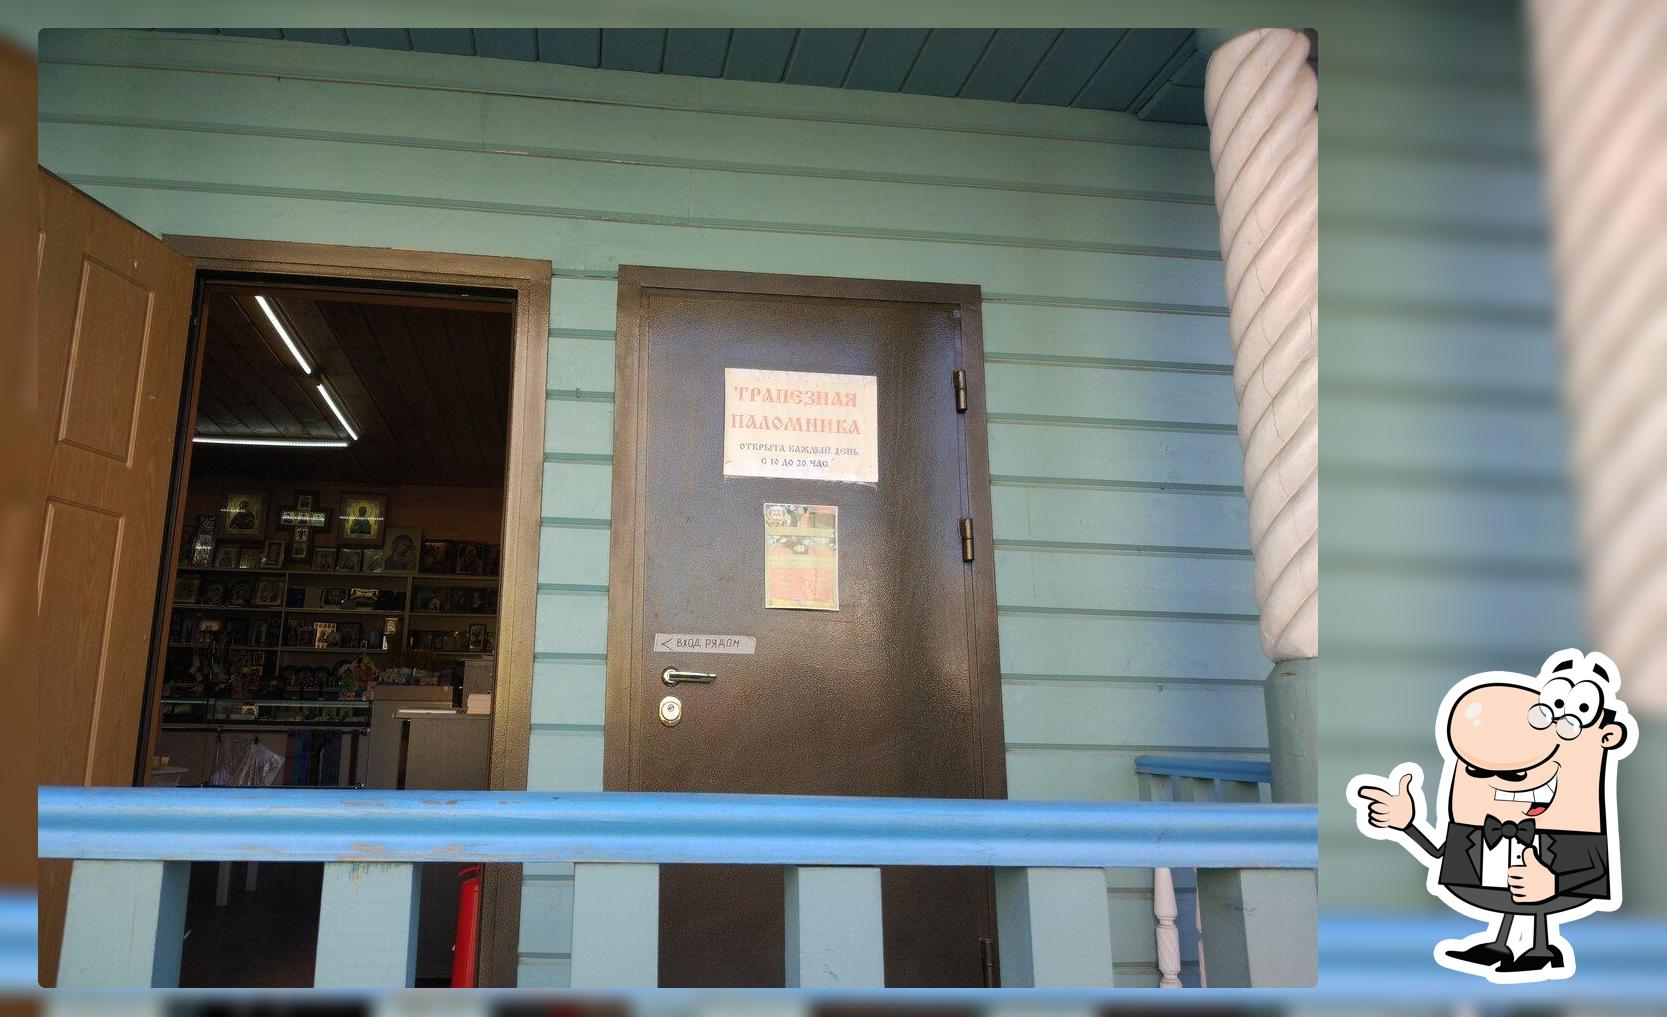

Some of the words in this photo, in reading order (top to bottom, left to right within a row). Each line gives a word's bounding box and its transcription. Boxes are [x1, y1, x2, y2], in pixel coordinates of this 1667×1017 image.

[734, 386, 858, 407] ТРАПЕЗНАЯ
[730, 413, 861, 435] ПАЛОМНИКА
[739, 442, 785, 453] ОТКРЫТА
[788, 445, 831, 455] КАЖДЫЙ
[781, 459, 794, 468] ДО
[676, 638, 701, 649] ВХОД
[704, 638, 740, 649] РЯДОМ
